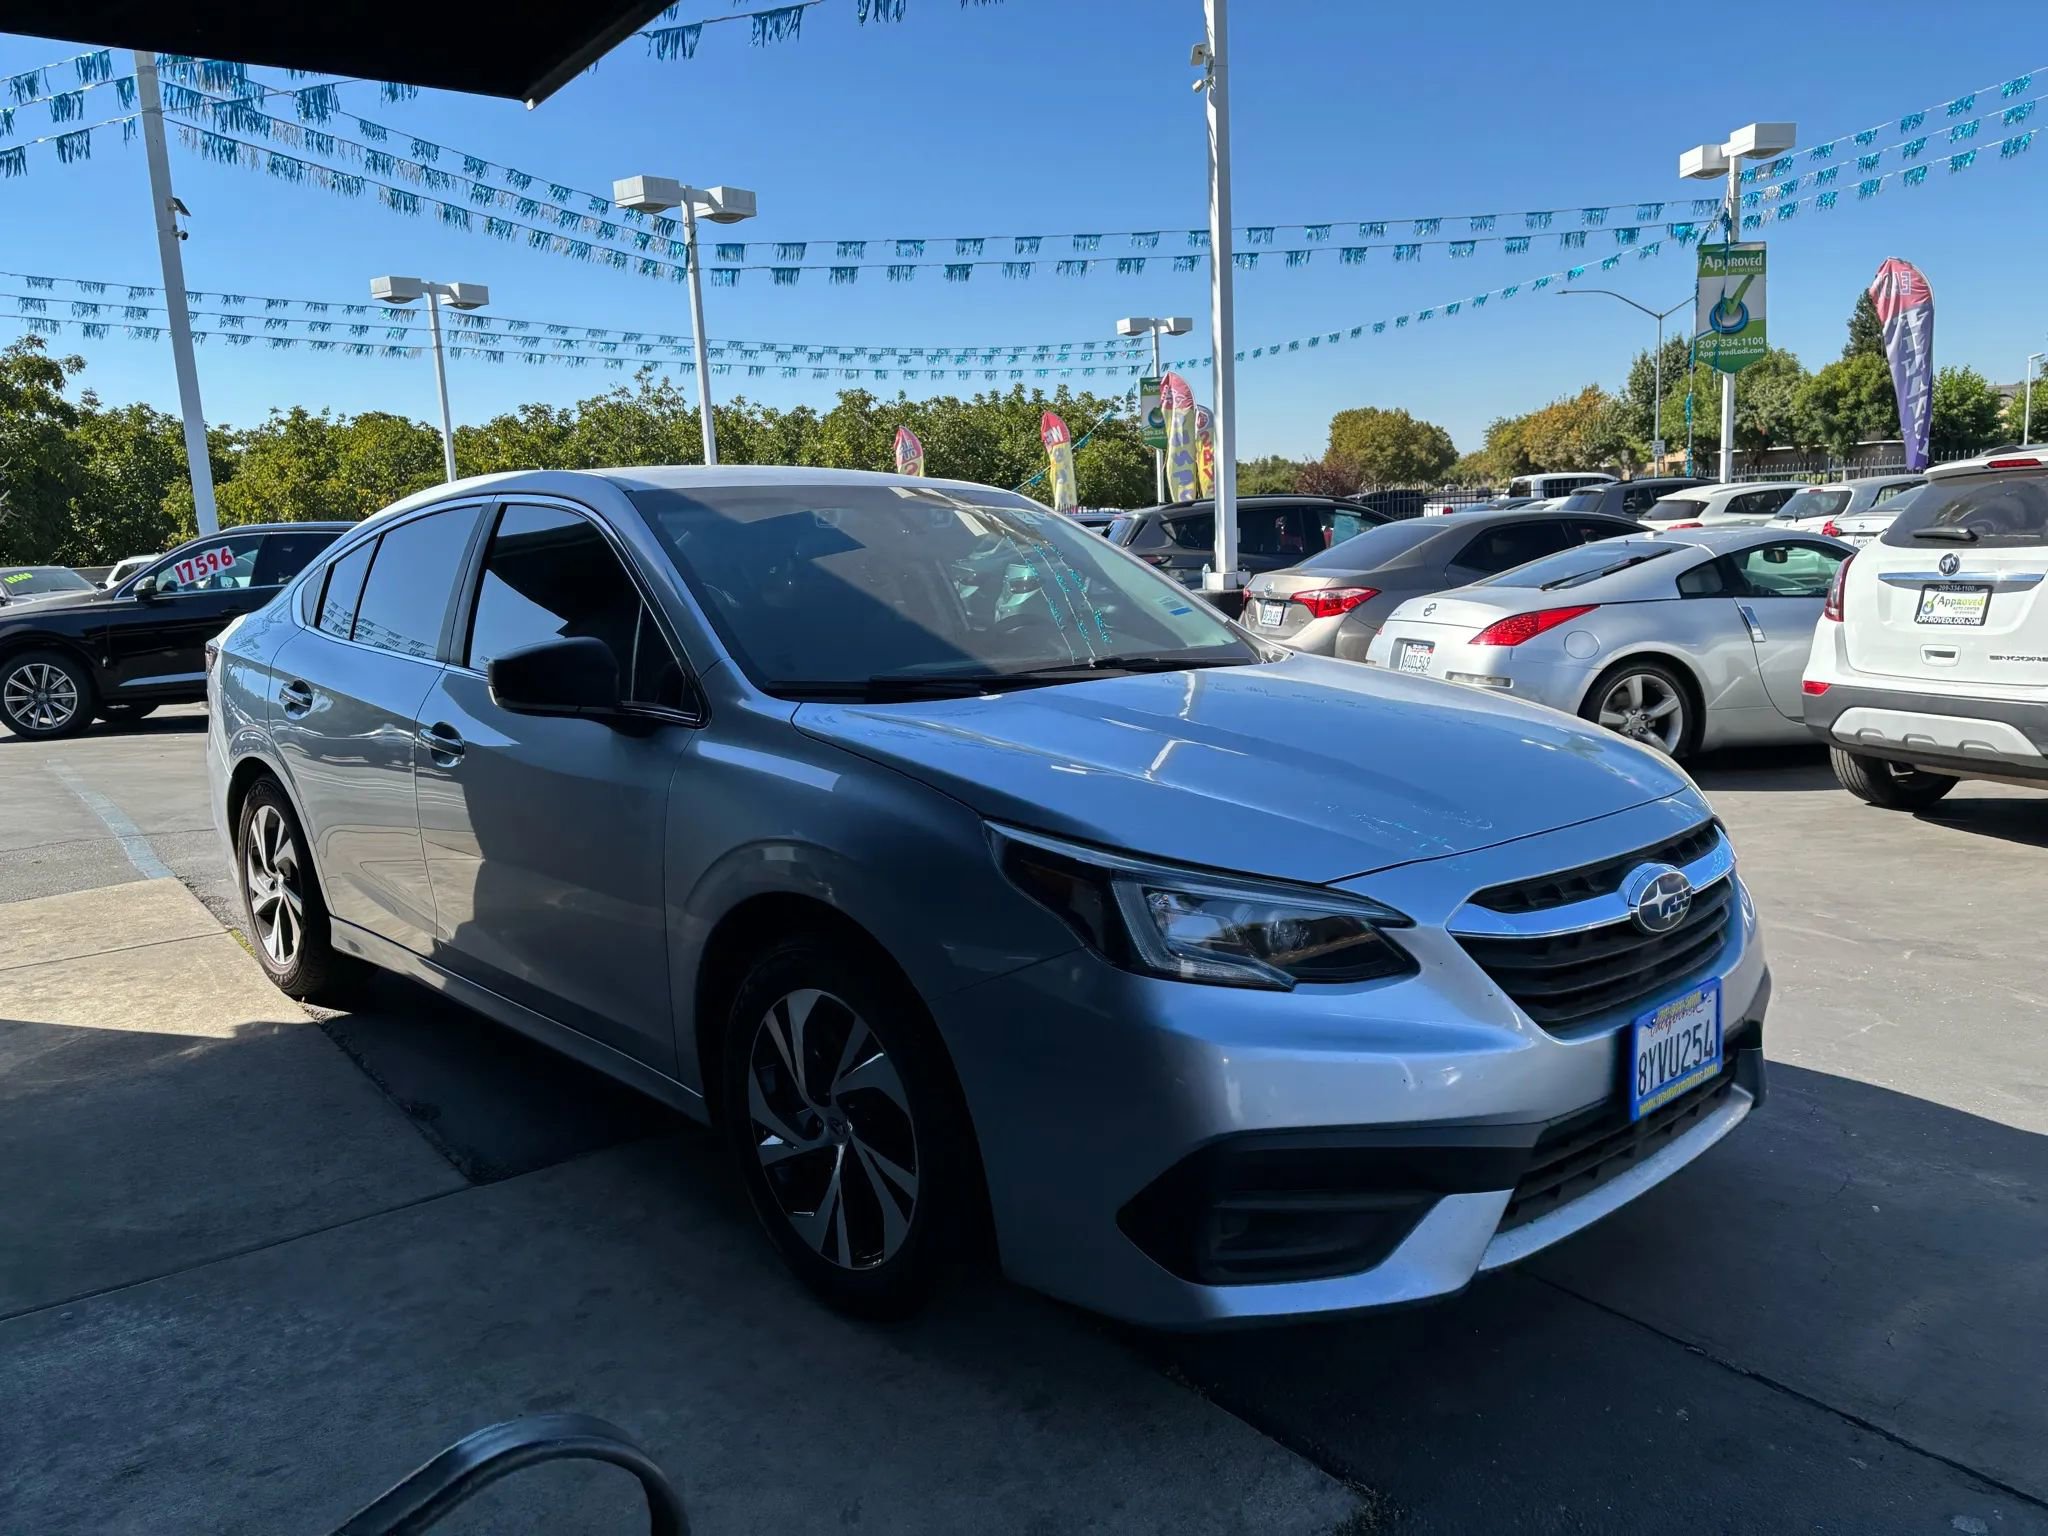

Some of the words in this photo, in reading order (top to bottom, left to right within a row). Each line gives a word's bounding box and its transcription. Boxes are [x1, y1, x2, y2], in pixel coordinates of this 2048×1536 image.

[1699, 336, 1764, 349] 209334.1100
[174, 547, 233, 585] 17596
[1638, 1019, 1714, 1097] 8YVU254
